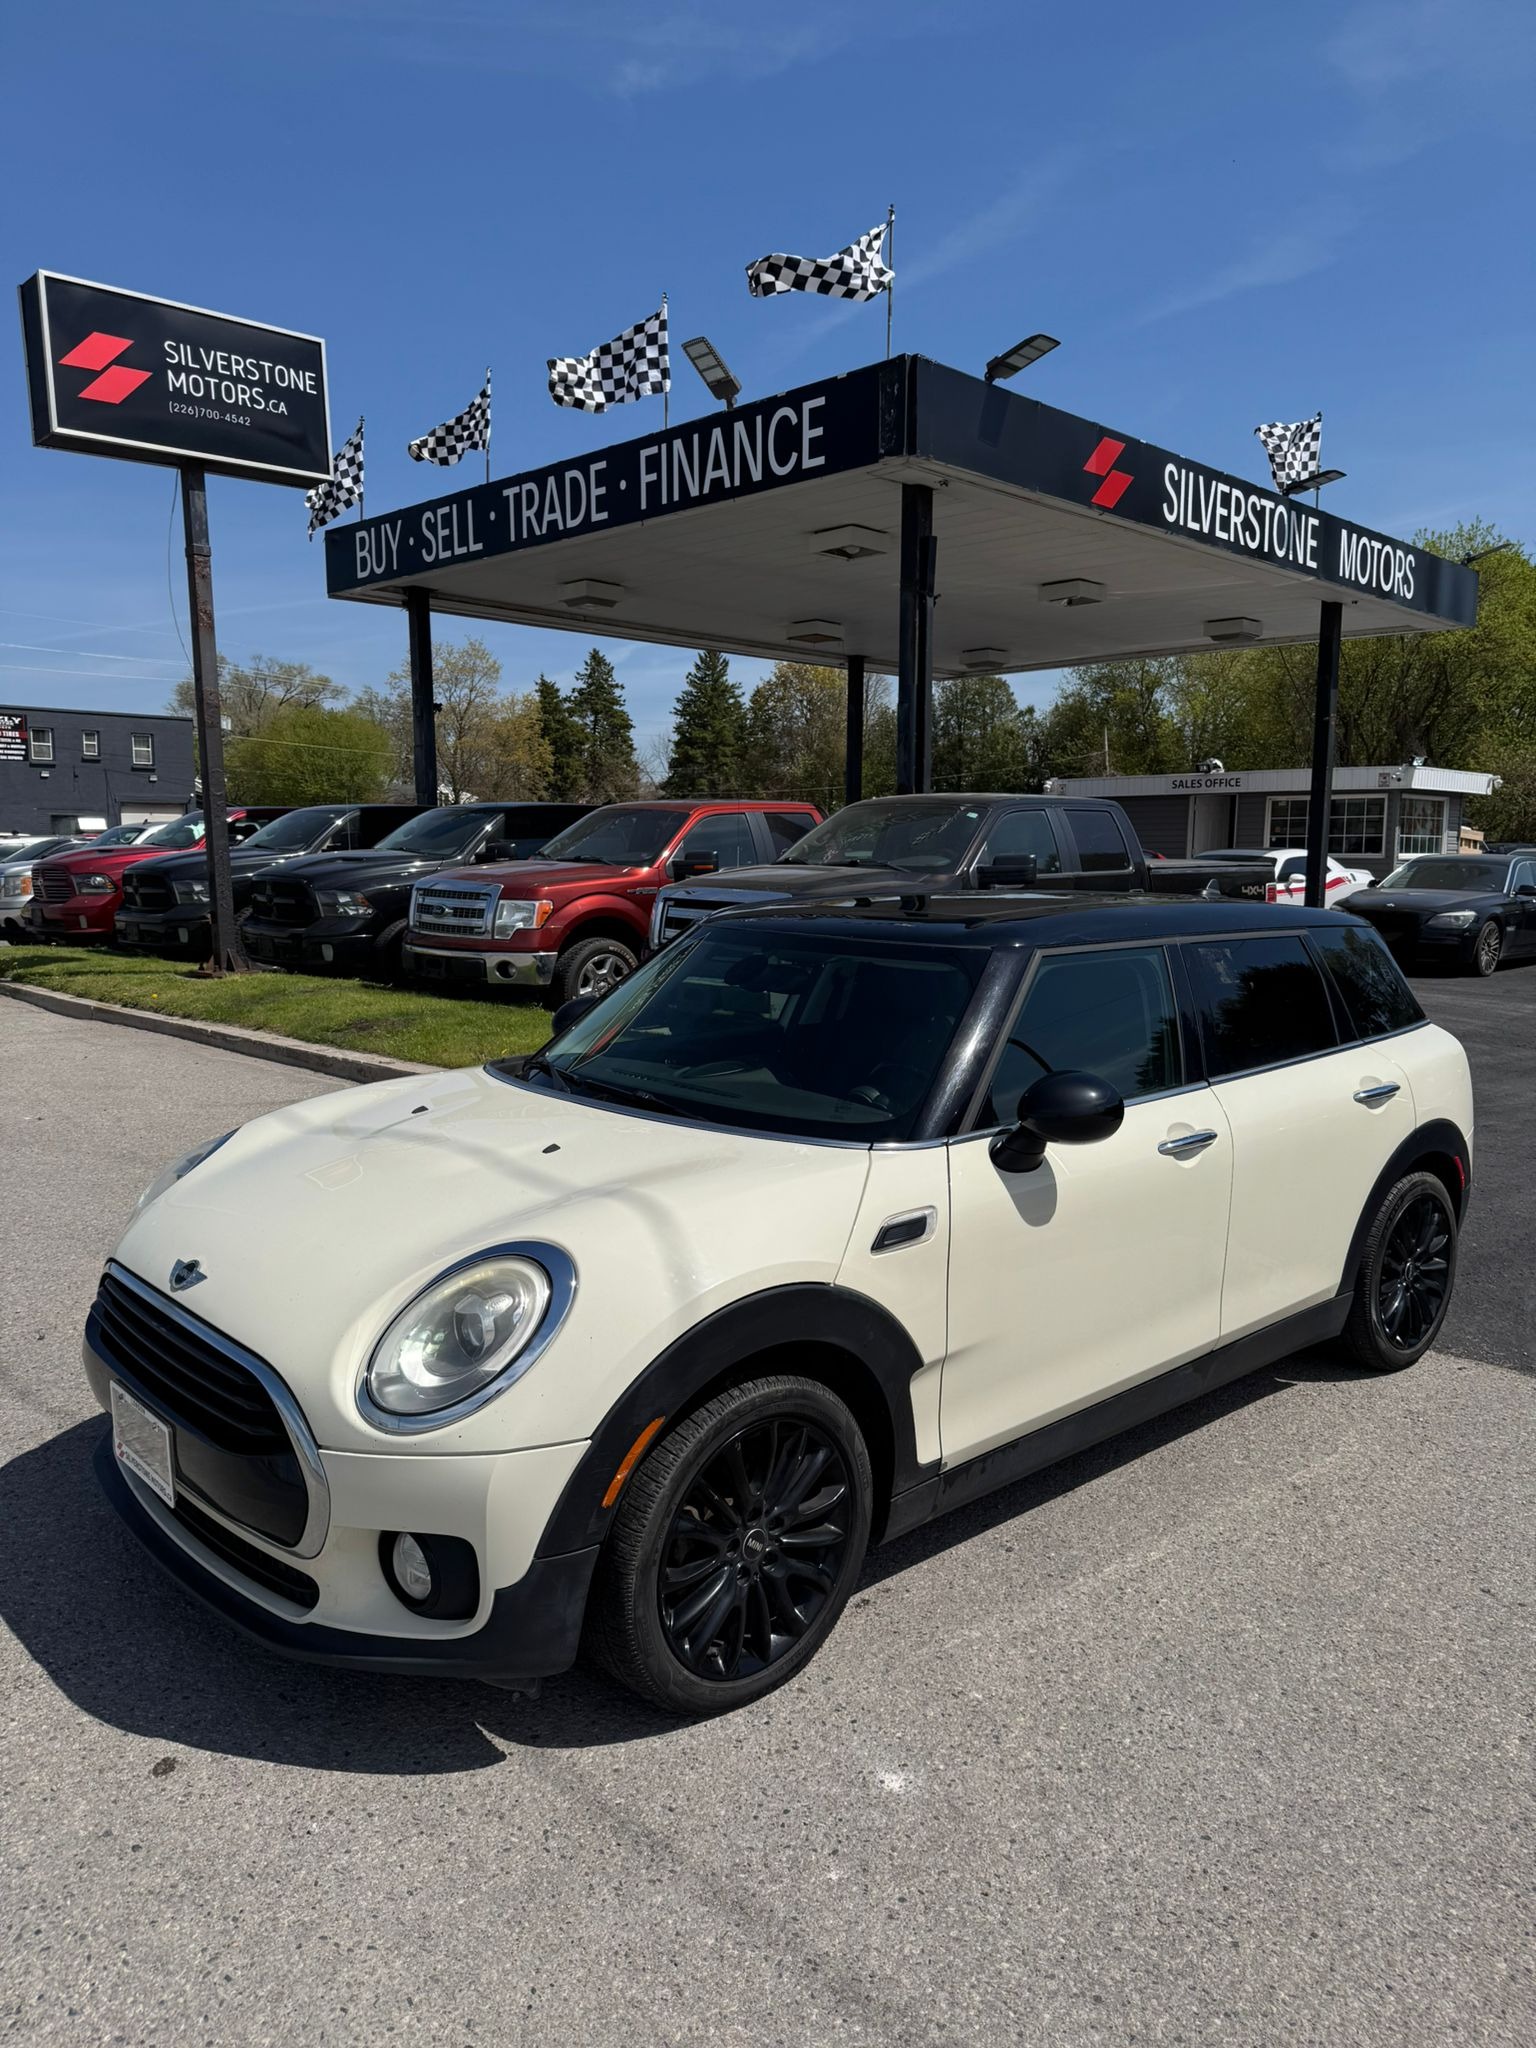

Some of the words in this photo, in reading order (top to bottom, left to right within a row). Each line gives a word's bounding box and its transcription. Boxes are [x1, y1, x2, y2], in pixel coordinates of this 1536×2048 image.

[164, 341, 317, 395] SILVERSTONE
[167, 369, 288, 416] MOTORS.CA
[168, 400, 251, 426] (226)700-4542
[354, 519, 402, 580] BUY
[420, 499, 484, 564] SELL
[502, 460, 609, 543] TRADE
[639, 396, 827, 511] FINANCE
[1162, 462, 1320, 569] SILVERSTONE
[1338, 528, 1416, 600] MOTORS
[1172, 780, 1202, 789] SALES
[1205, 778, 1241, 788] OFFICE
[747, 1538, 763, 1552] MINI
